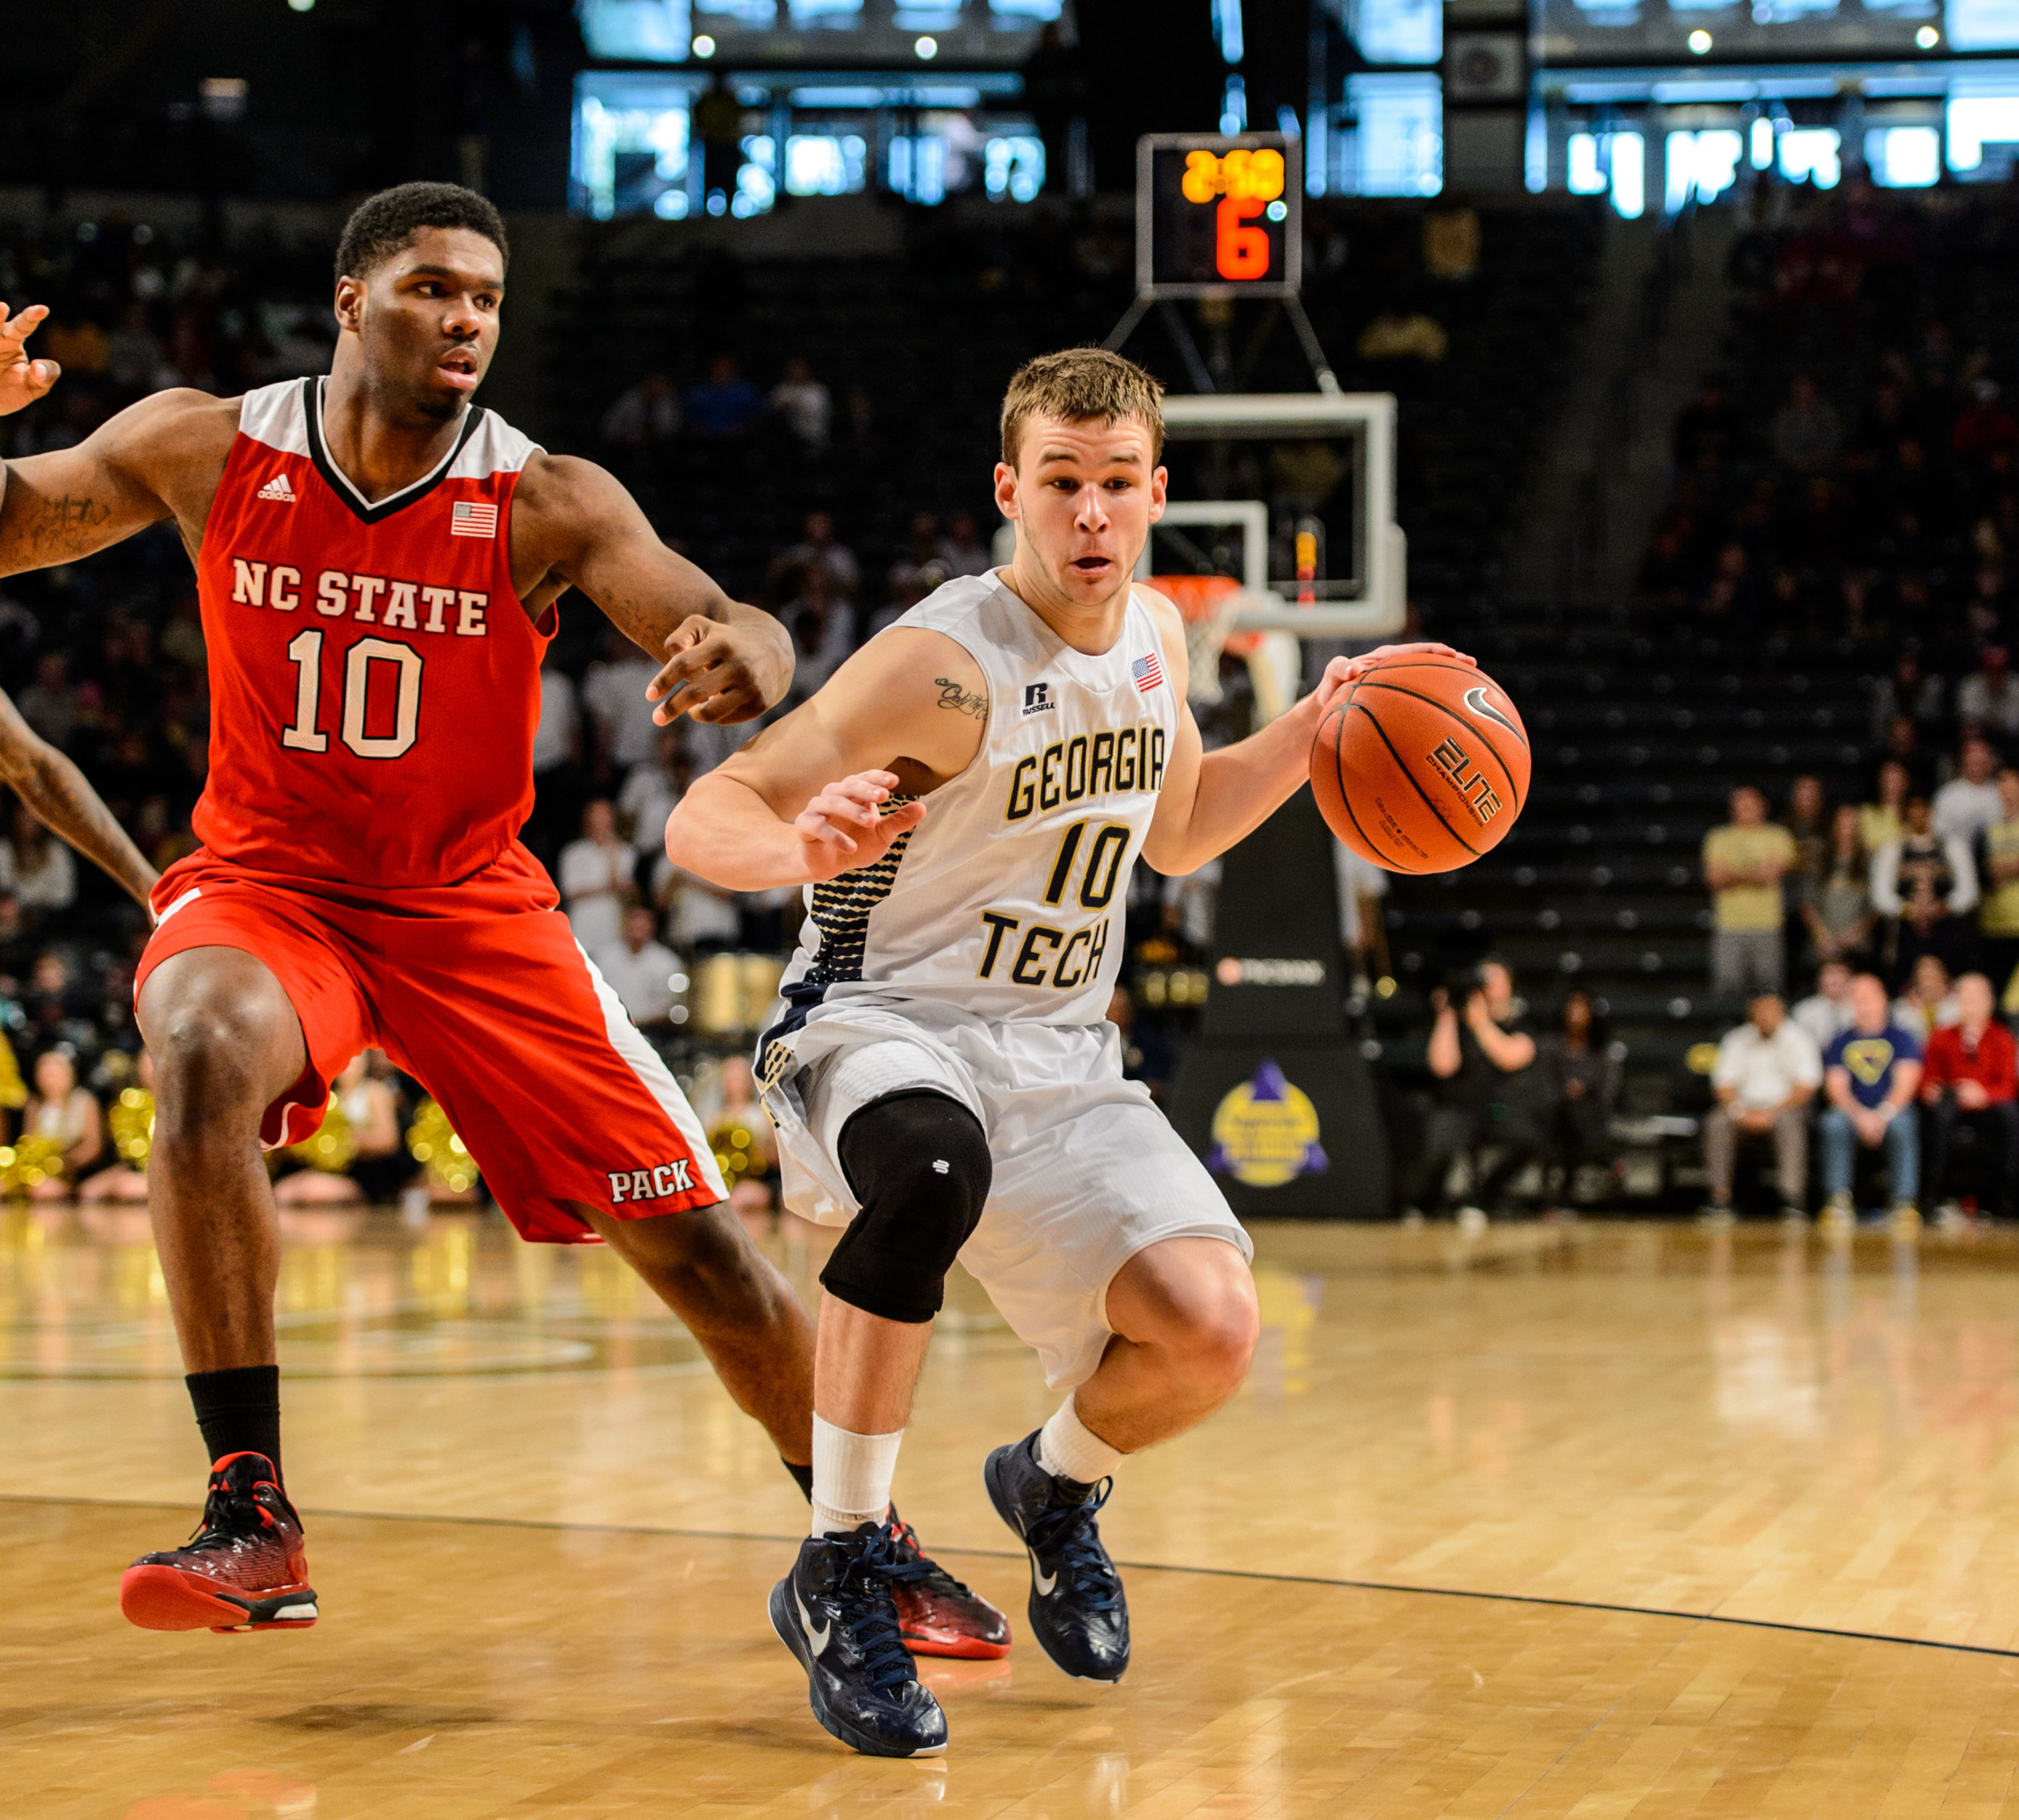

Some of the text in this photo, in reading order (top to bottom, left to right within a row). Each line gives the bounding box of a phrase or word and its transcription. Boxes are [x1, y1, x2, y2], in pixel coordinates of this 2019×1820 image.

[1216, 198, 1270, 279] 6
[257, 490, 296, 502] adidas
[232, 558, 302, 612] NC
[315, 569, 489, 637] STATE
[281, 627, 425, 760] 10
[1022, 702, 1056, 717] RUSSELL
[1005, 725, 1166, 822] GEORGIA
[1425, 754, 1484, 828] CHAMPIONSHIP
[1431, 736, 1503, 824] ELITE
[1041, 817, 1132, 913] 10
[975, 909, 1110, 989] TECH
[607, 1158, 697, 1204] PACK
